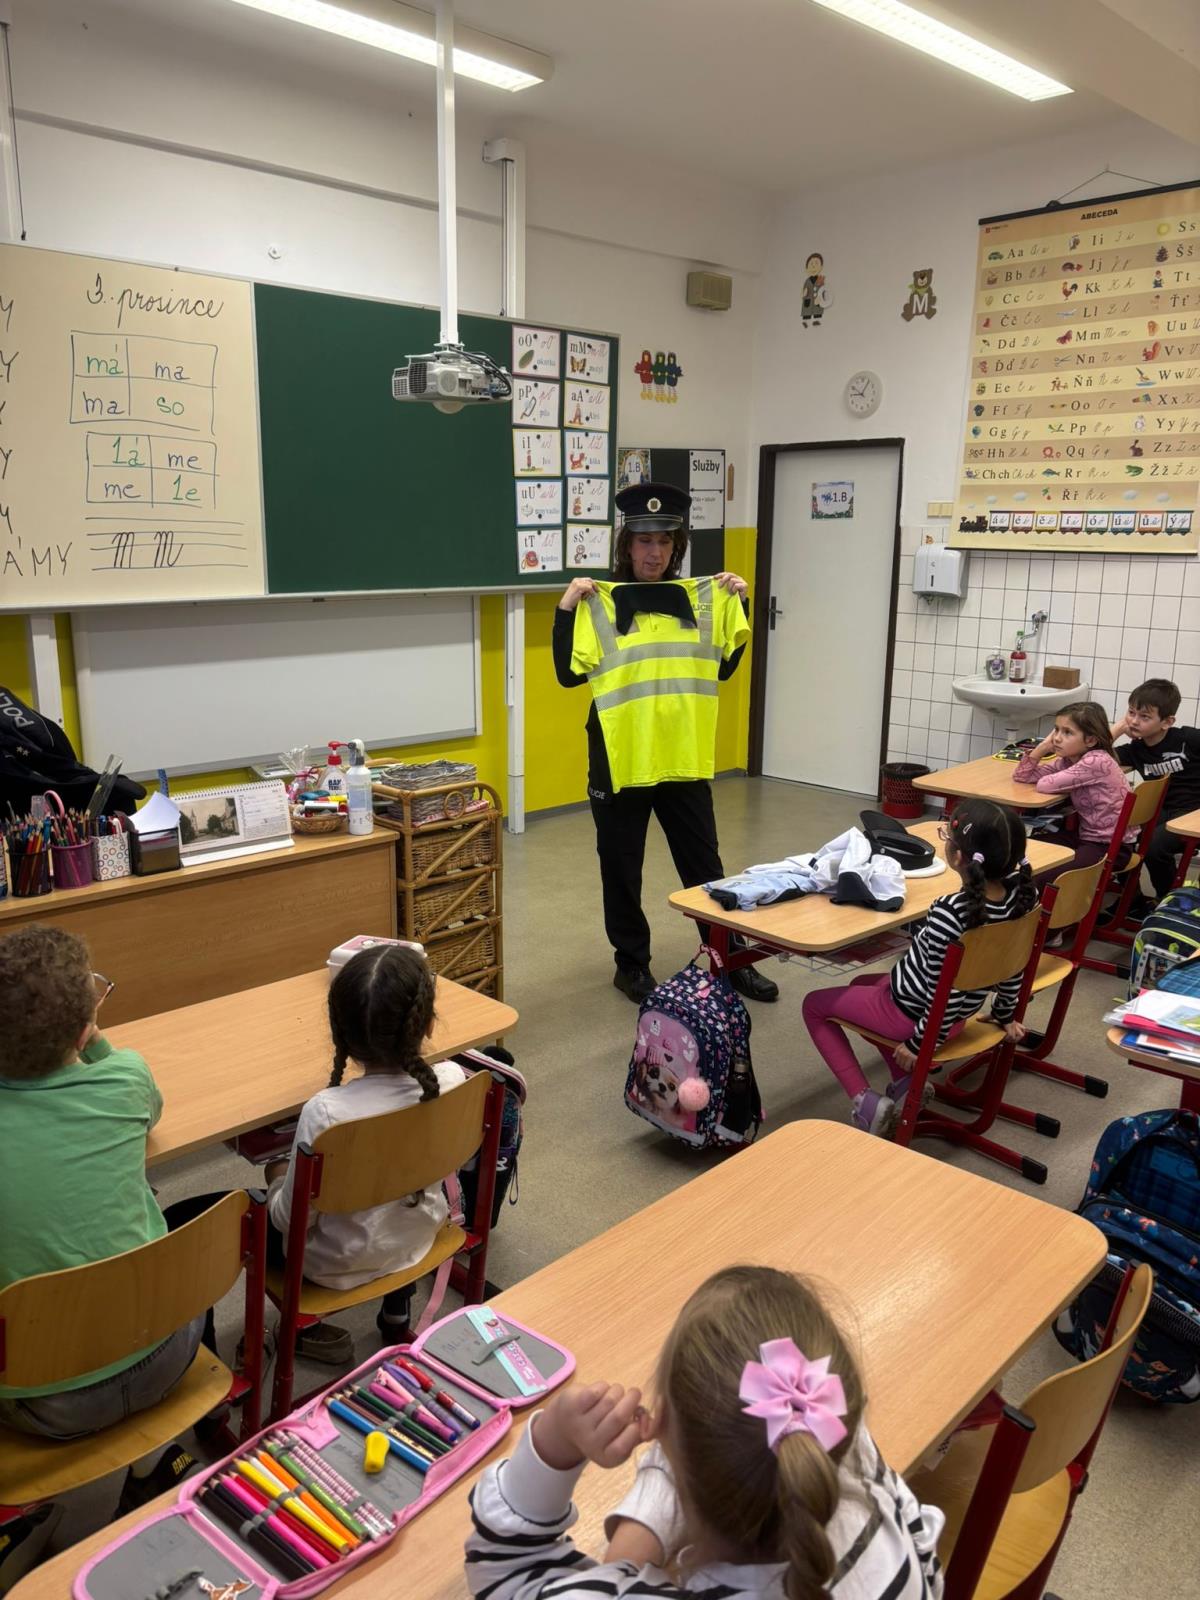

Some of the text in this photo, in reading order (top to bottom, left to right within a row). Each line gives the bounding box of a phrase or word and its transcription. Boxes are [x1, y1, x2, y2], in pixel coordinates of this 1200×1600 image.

[1081, 209, 1118, 220] ABECEDA
[113, 288, 225, 328] prosince
[913, 294, 928, 314] M
[86, 344, 191, 380] má ma
[83, 392, 185, 416] ma so
[168, 453, 203, 470] me
[693, 460, 720, 474] Služby
[104, 482, 142, 499] me
[1144, 758, 1184, 776] PUMA
